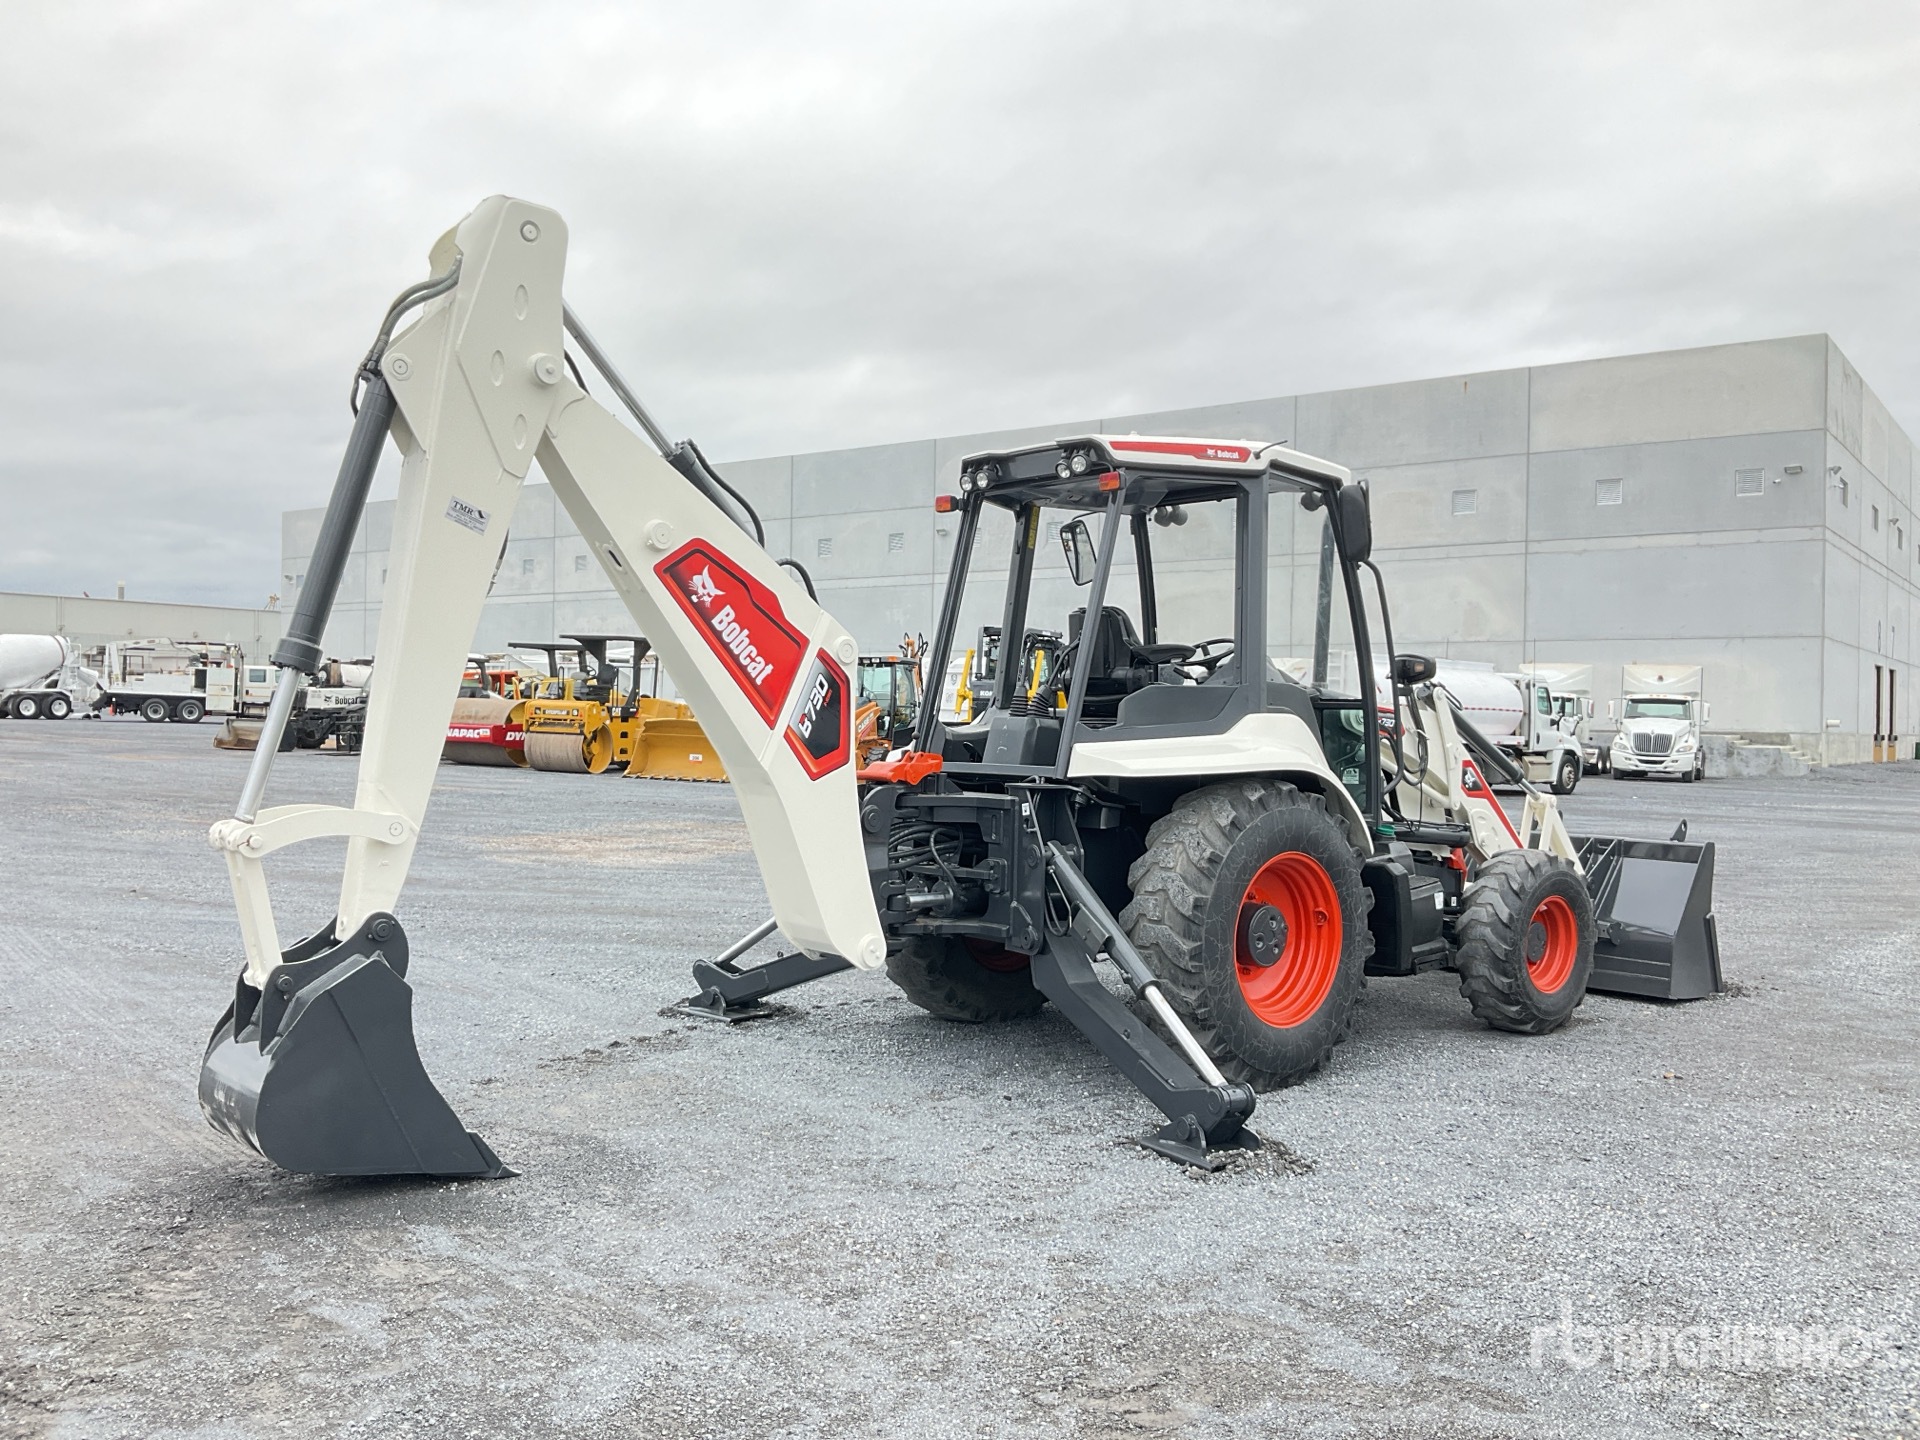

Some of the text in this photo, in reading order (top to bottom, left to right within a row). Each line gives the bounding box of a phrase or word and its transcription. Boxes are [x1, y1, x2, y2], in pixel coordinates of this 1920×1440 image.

[1217, 450, 1239, 459] Bobcat
[453, 500, 474, 516] TMR
[711, 604, 774, 686] Bobcat
[798, 673, 829, 739] B730
